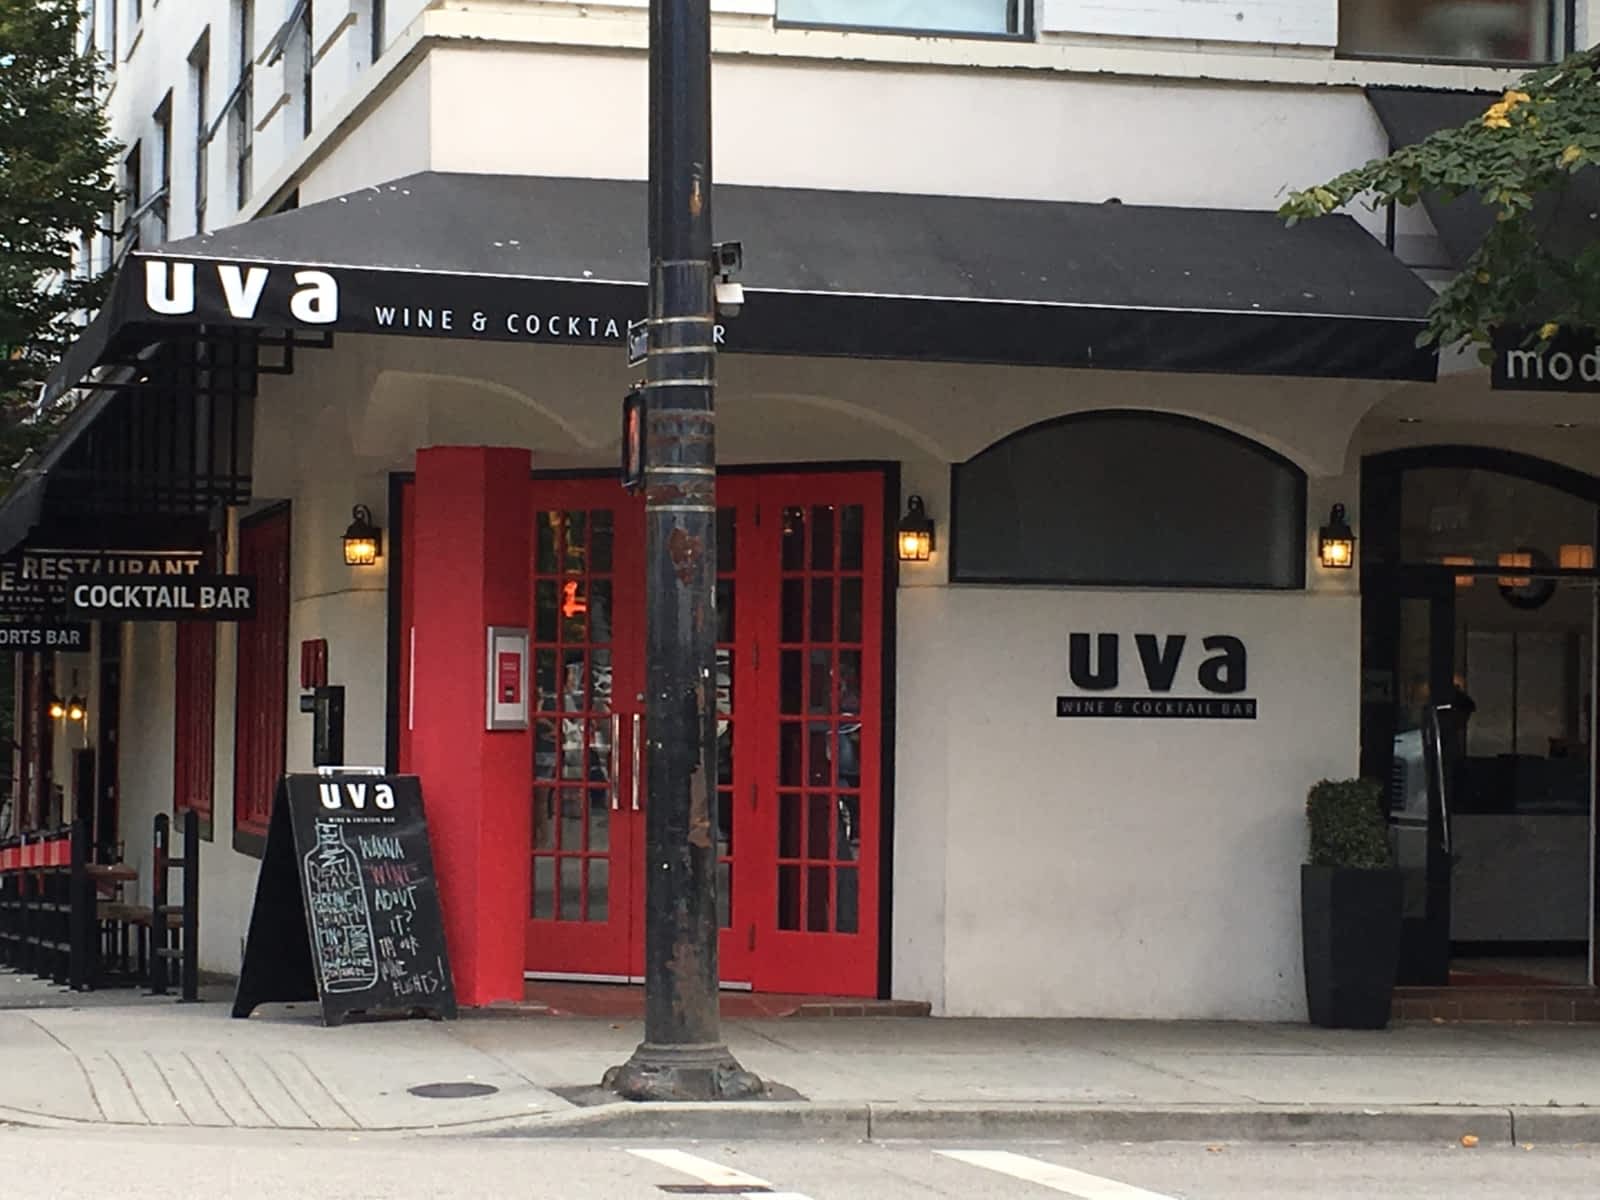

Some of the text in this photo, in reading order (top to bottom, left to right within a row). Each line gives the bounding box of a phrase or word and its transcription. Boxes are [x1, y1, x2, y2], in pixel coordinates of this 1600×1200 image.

[145, 259, 338, 325] uva
[375, 305, 453, 331] WINE
[471, 312, 488, 332] &
[74, 585, 195, 608] COCKTAIL
[199, 587, 251, 609] BAR
[45, 630, 81, 645] BAR
[1069, 632, 1247, 694] uva
[1062, 701, 1256, 716] WINE & COCKTAIL BAR
[319, 782, 395, 811] uva
